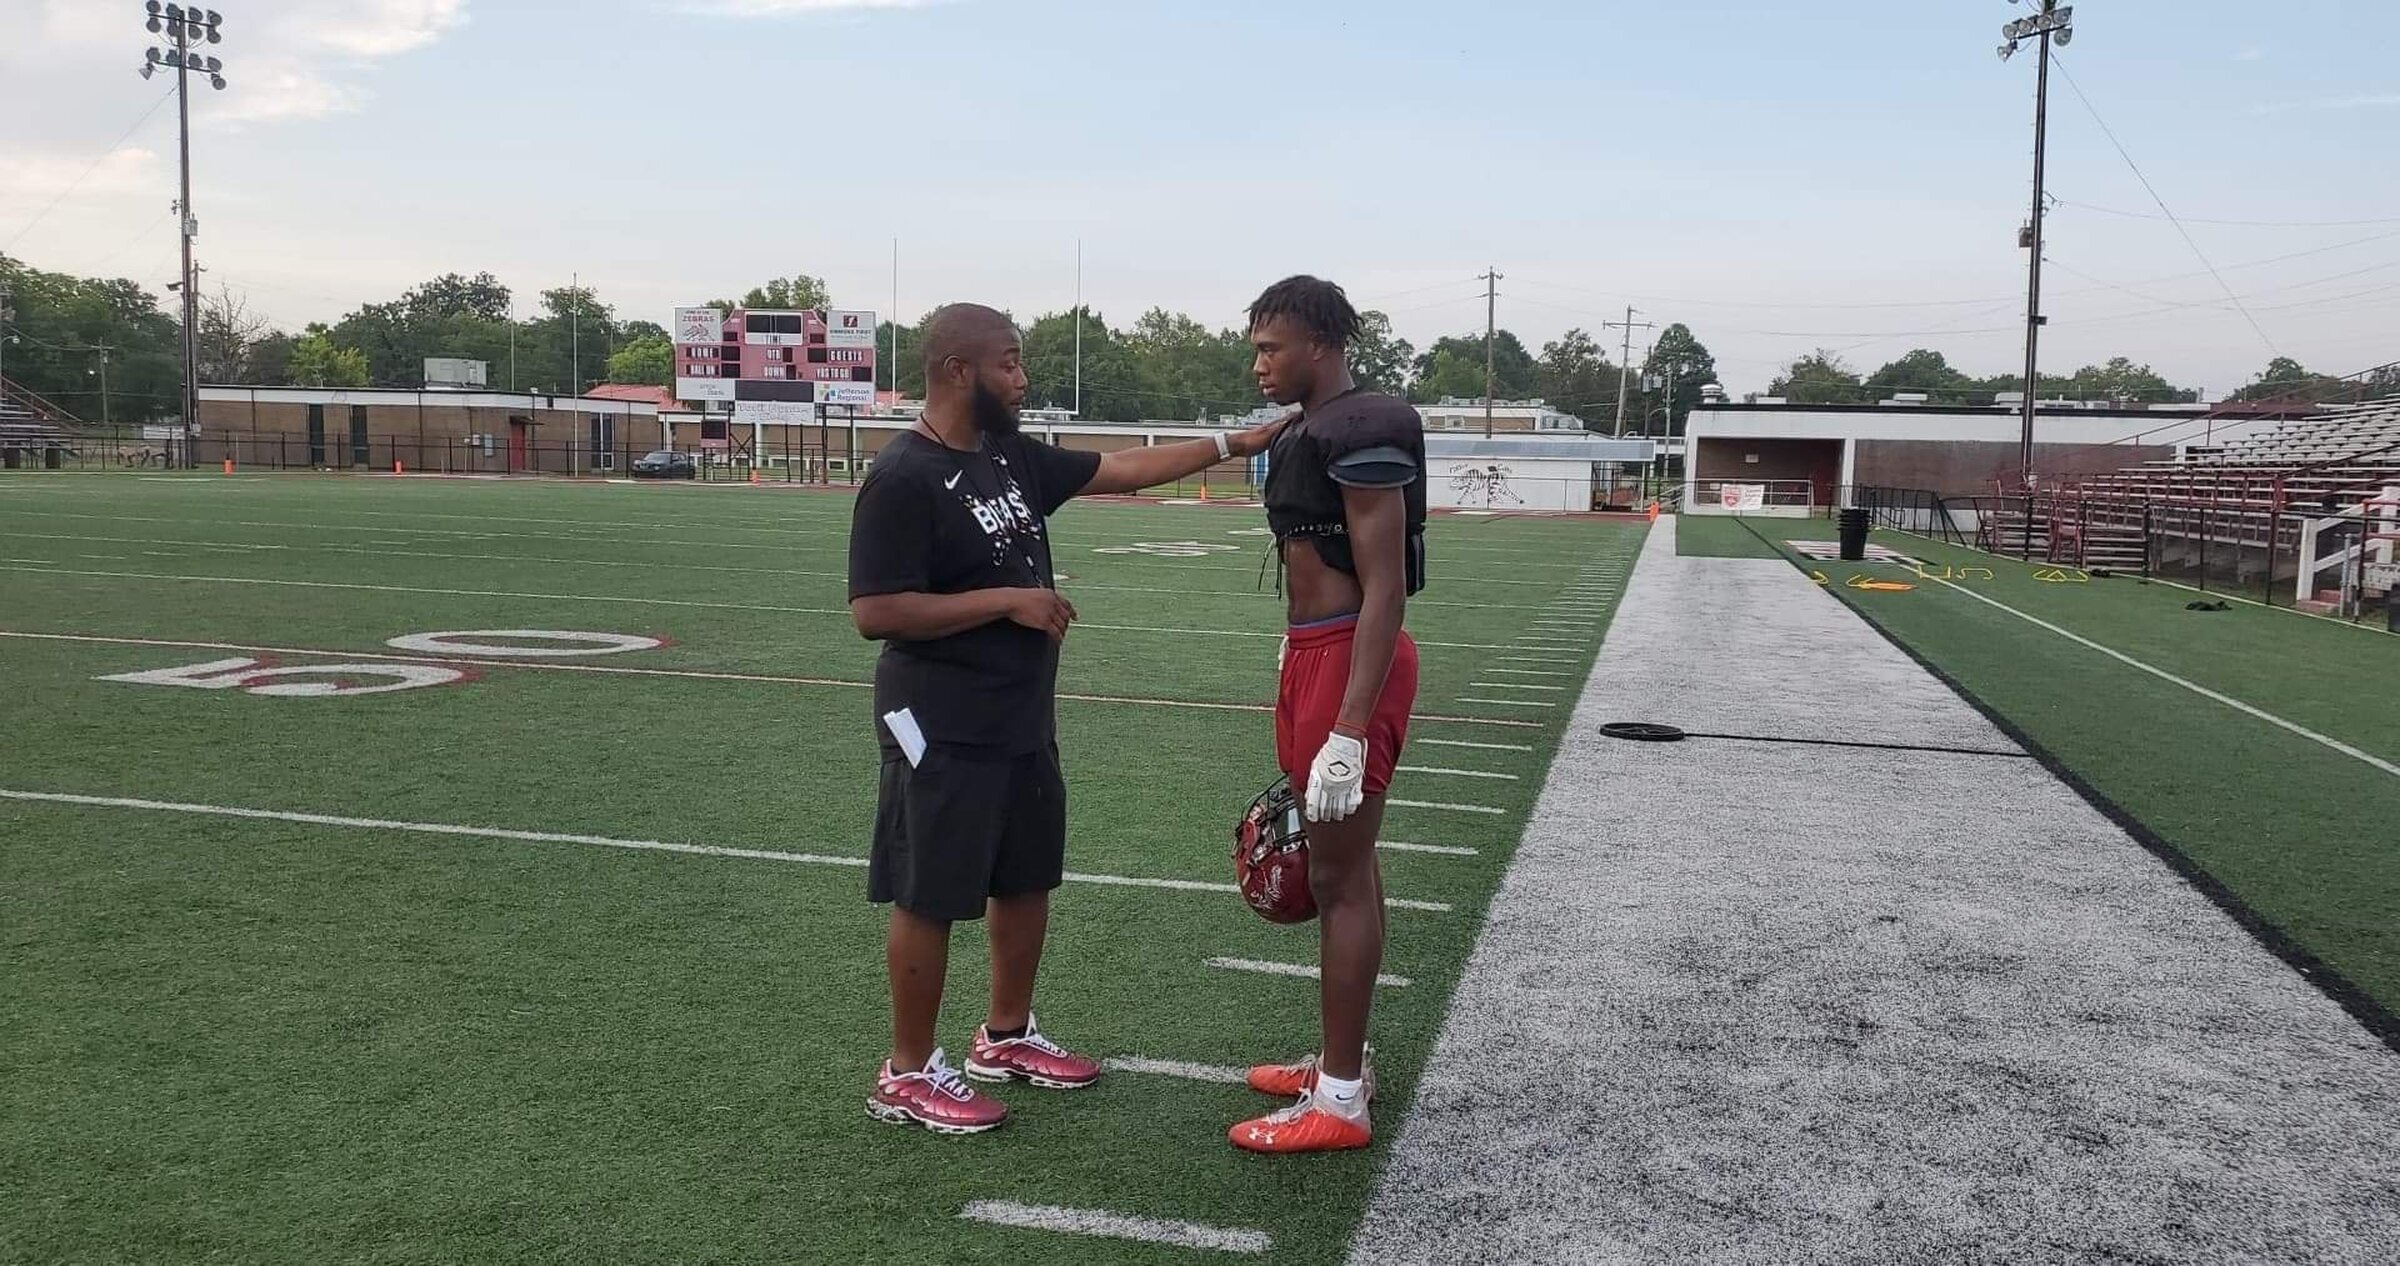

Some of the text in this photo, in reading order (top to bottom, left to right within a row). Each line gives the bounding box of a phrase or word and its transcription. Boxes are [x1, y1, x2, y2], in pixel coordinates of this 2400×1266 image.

[765, 334, 781, 345] TIME
[691, 347, 713, 358] HOME
[767, 349, 781, 360] QTR
[830, 350, 863, 361] GUESTS
[690, 365, 716, 375] BALL ON
[764, 366, 785, 378] DOWN
[831, 368, 839, 378] TO
[840, 368, 850, 378] GO
[837, 388, 869, 396] Jefferson
[837, 394, 868, 402] Regional
[92, 629, 674, 697] 50
